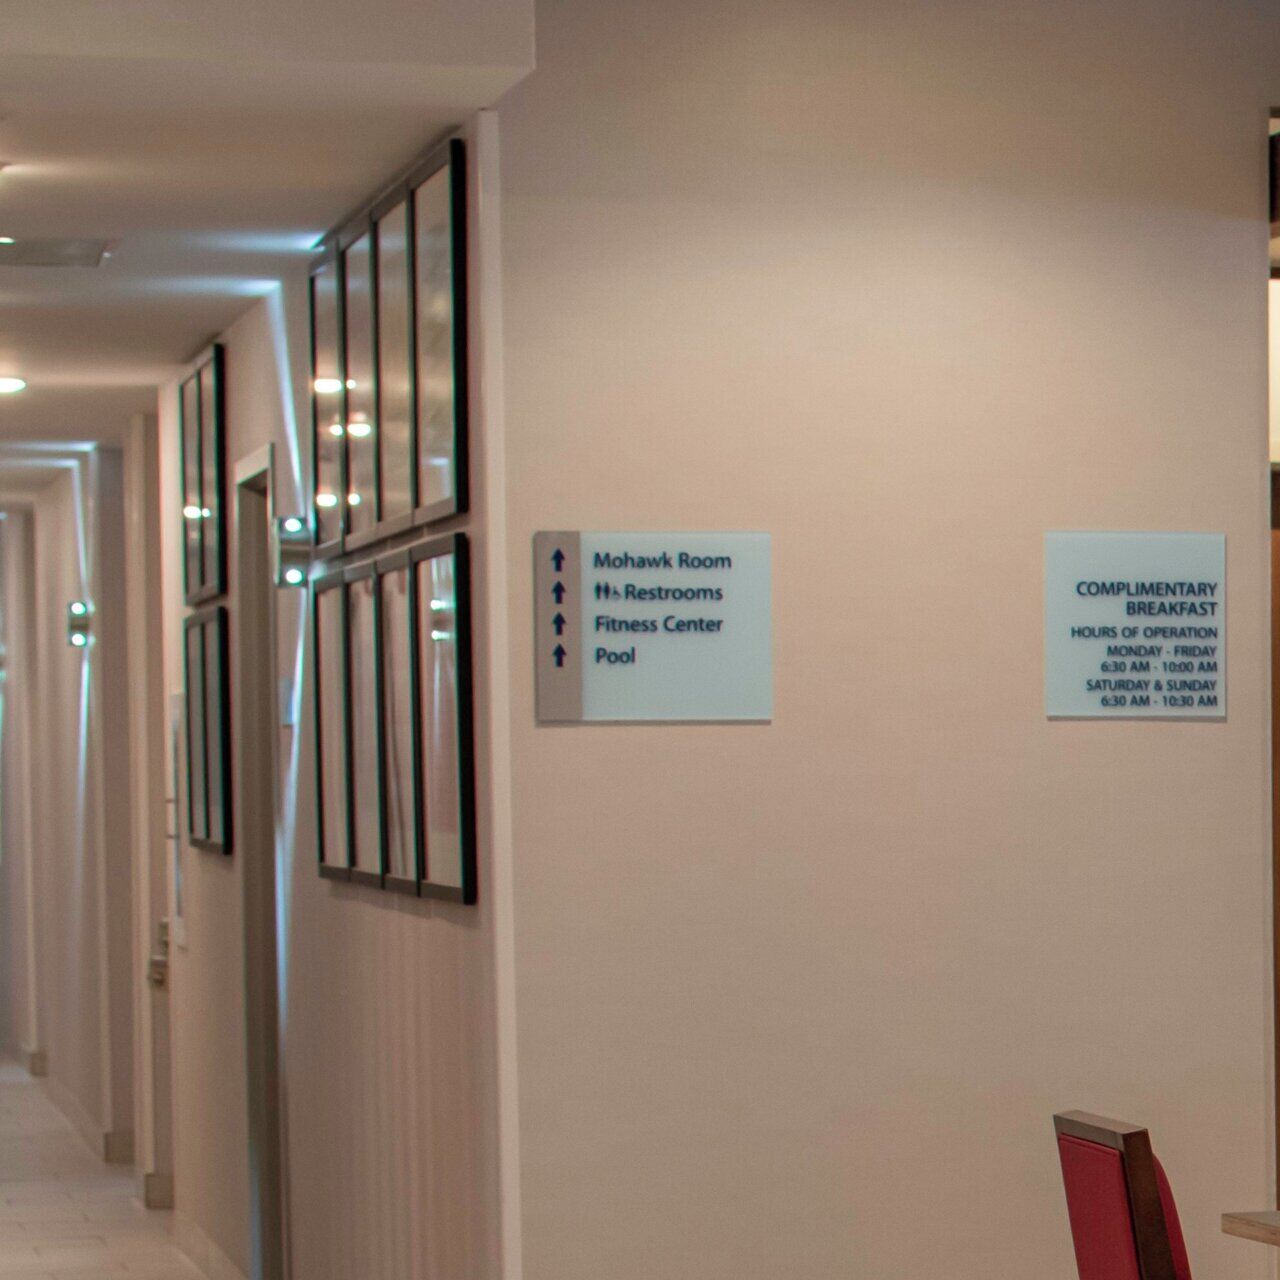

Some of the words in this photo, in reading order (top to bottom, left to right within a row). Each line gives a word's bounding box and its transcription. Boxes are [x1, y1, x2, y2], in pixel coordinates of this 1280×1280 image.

[593, 552, 673, 570] Mohawk
[678, 552, 732, 570] Room
[624, 583, 724, 601] Restrooms
[1076, 580, 1218, 597] COMPLIMENTARY
[1126, 601, 1218, 616] BREAKFAST
[594, 614, 658, 632] Fitness
[663, 615, 724, 632] Center
[1071, 626, 1118, 639] HOURS
[1121, 626, 1139, 639] OF
[1143, 626, 1218, 639] OPERATION
[594, 646, 636, 664] Pool
[1106, 645, 1163, 657] MONDAY
[1173, 645, 1217, 657] FRIDAY
[1100, 661, 1127, 673] 6:30
[1129, 661, 1150, 673] AM
[1162, 661, 1194, 673] 10:00
[1197, 661, 1218, 673] AM
[1086, 679, 1150, 691] SATURDAY
[1153, 679, 1163, 691] &
[1166, 679, 1217, 691] SUNDAY
[1100, 695, 1127, 707] 6:30
[1129, 695, 1150, 707] AM
[1162, 695, 1194, 707] 10:30
[1197, 695, 1218, 707] AM
